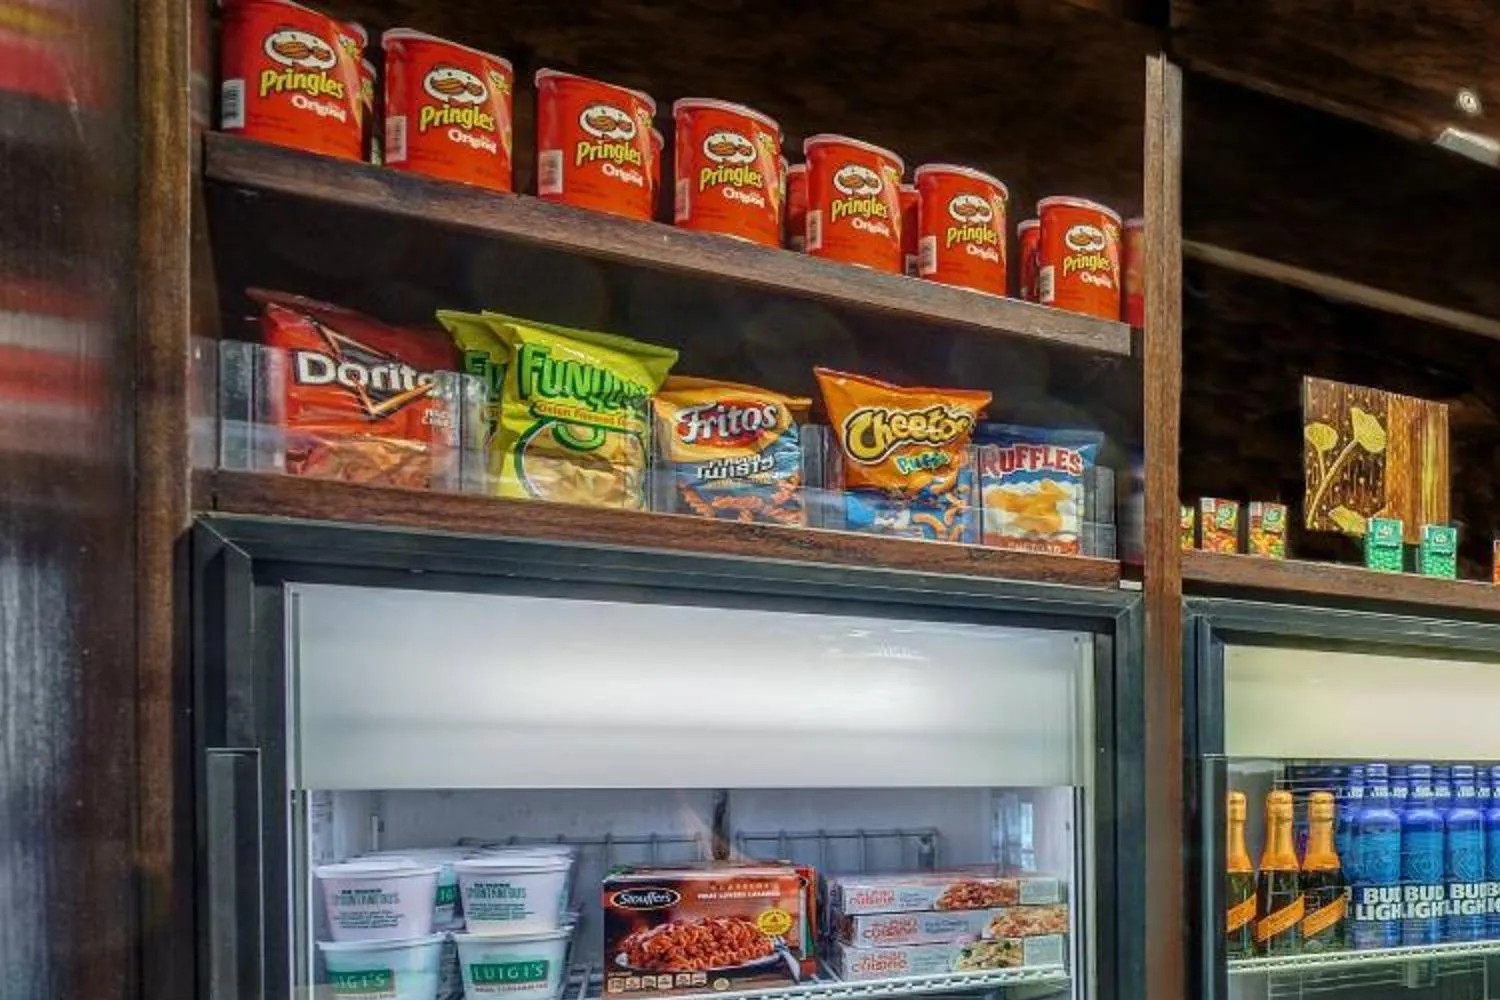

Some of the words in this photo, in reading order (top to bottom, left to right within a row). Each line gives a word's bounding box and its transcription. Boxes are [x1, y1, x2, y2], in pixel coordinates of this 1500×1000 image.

[259, 67, 345, 99] Pringles
[419, 102, 495, 131] Pringles
[576, 140, 642, 166] Pringles
[700, 166, 764, 190] Pringles
[831, 195, 889, 220] Pringles
[946, 223, 998, 247] Pringles
[673, 402, 778, 443] Fritos
[845, 406, 973, 460] Cheetos
[979, 445, 1084, 477] RUFFLES
[1356, 904, 1400, 921] LIGH
[1401, 902, 1444, 919] IGH
[1445, 900, 1485, 915] LIGH
[474, 963, 545, 981] LUIGI'S
